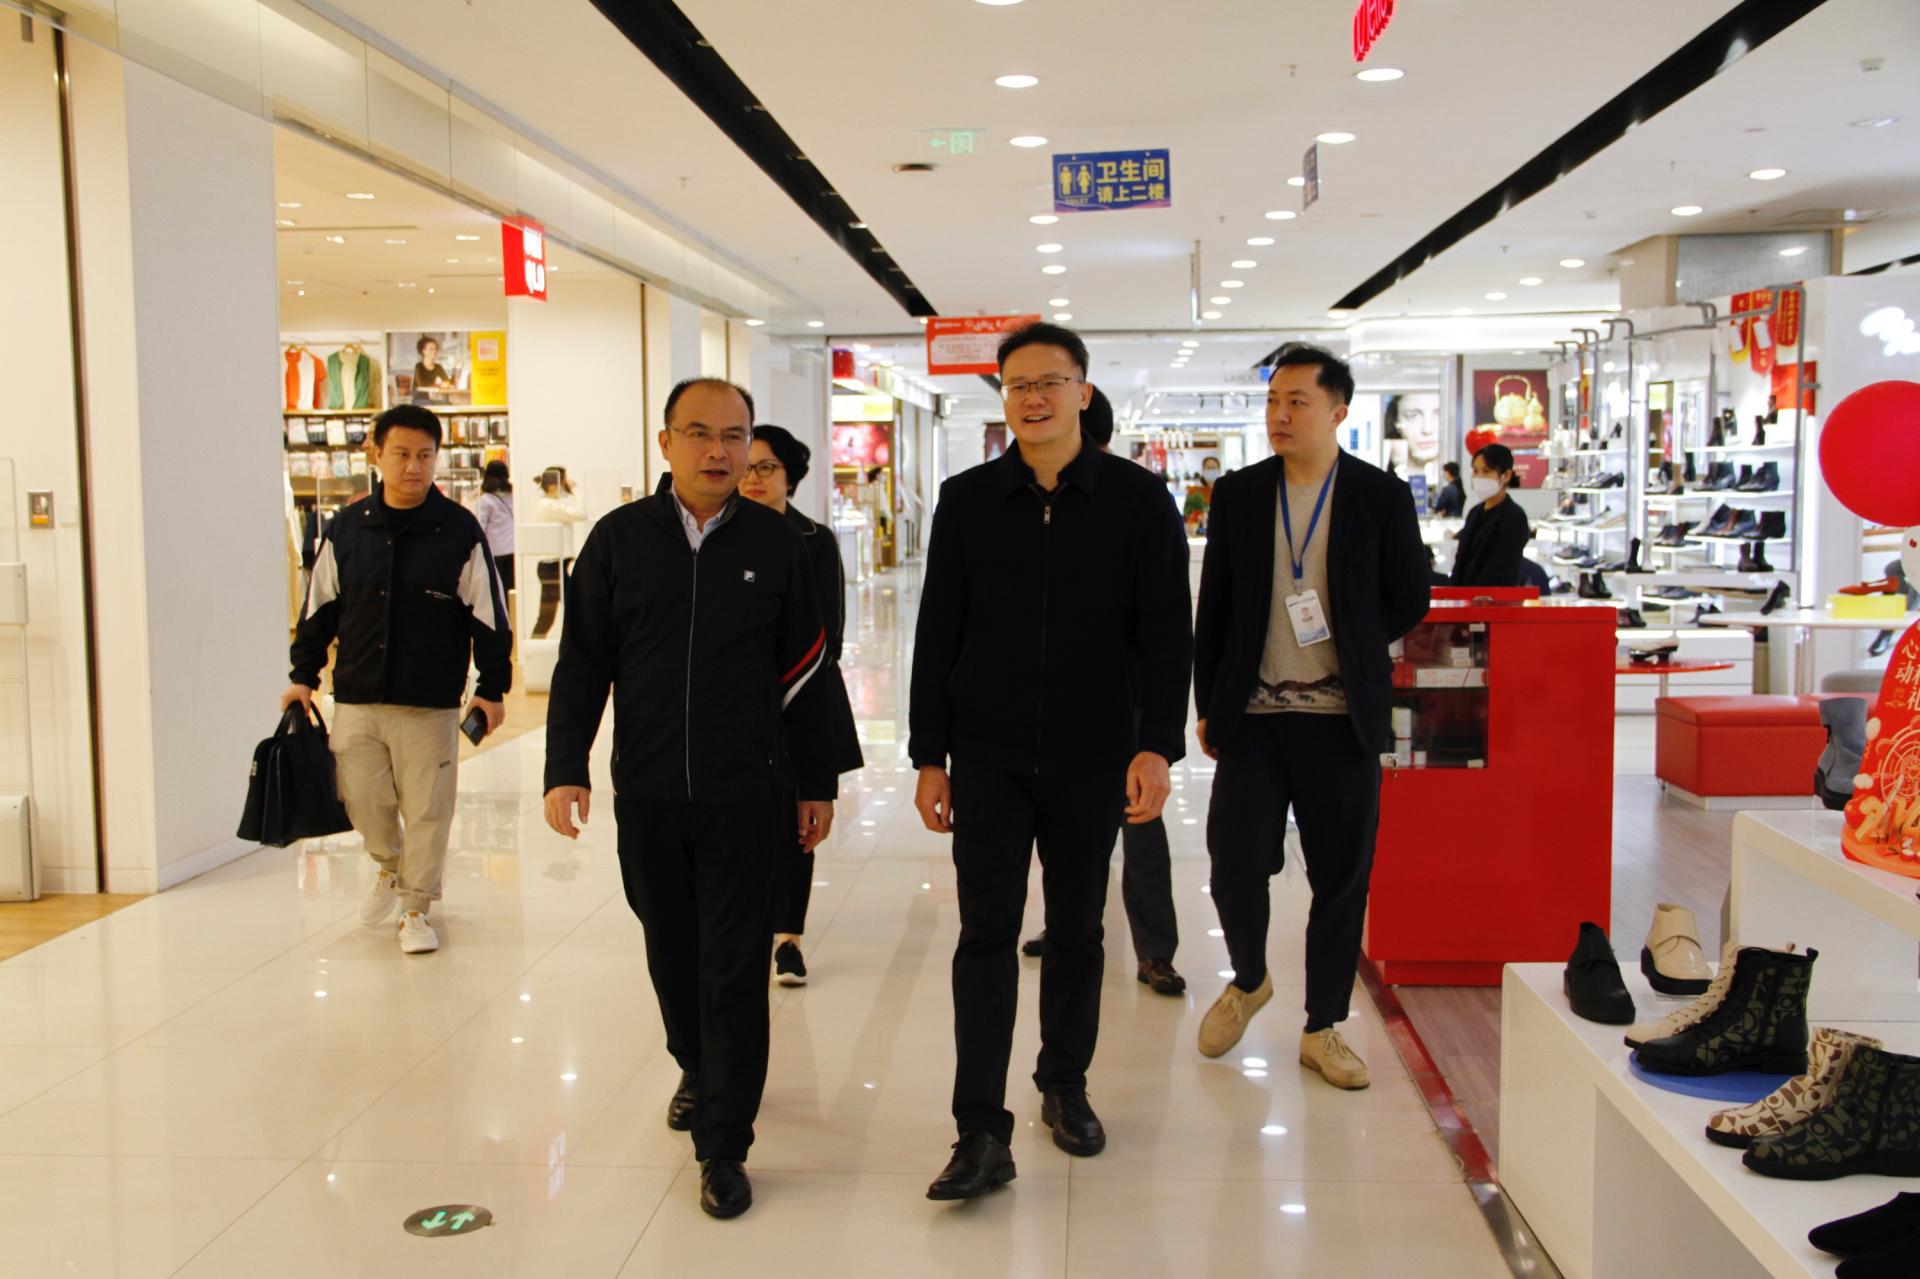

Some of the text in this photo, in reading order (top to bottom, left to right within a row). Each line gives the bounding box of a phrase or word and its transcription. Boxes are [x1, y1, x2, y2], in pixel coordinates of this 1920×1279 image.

[1097, 159, 1164, 183] 卫生间
[1097, 183, 1164, 203] 请上二楼
